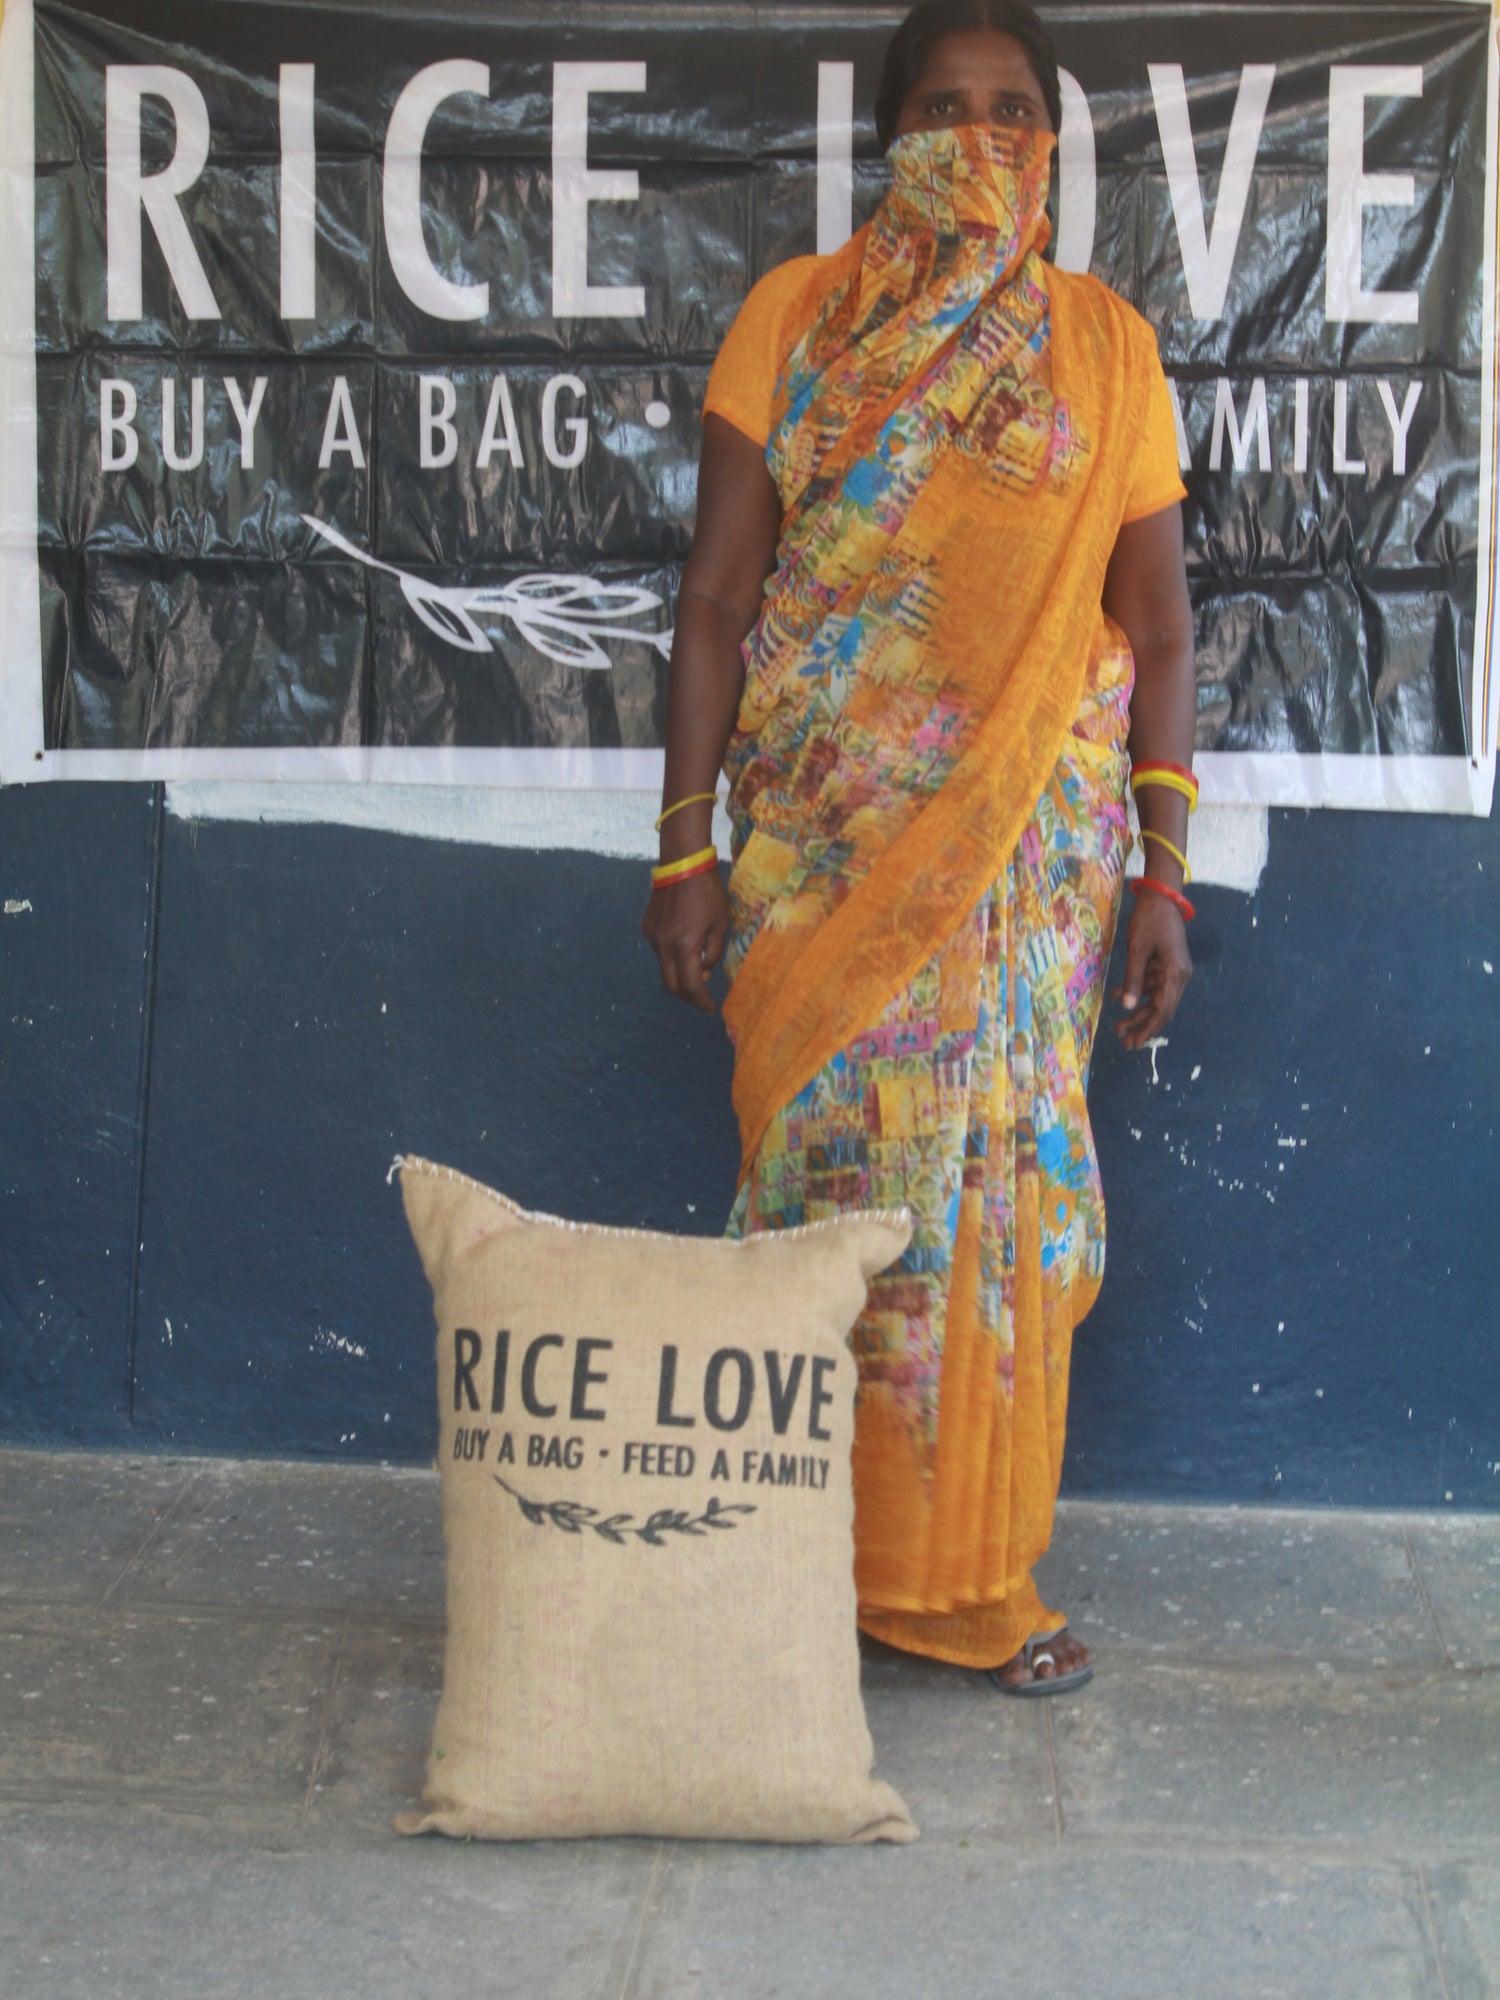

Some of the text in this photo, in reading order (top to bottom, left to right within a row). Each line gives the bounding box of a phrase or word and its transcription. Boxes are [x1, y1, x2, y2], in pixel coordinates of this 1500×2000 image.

[105, 59, 1423, 323] RICE LVE
[101, 374, 1423, 475] BUY A BAG MILY
[454, 1328, 837, 1442] RICE LOVE
[453, 1427, 831, 1490] BUY A BAG FEED A FAMILY
